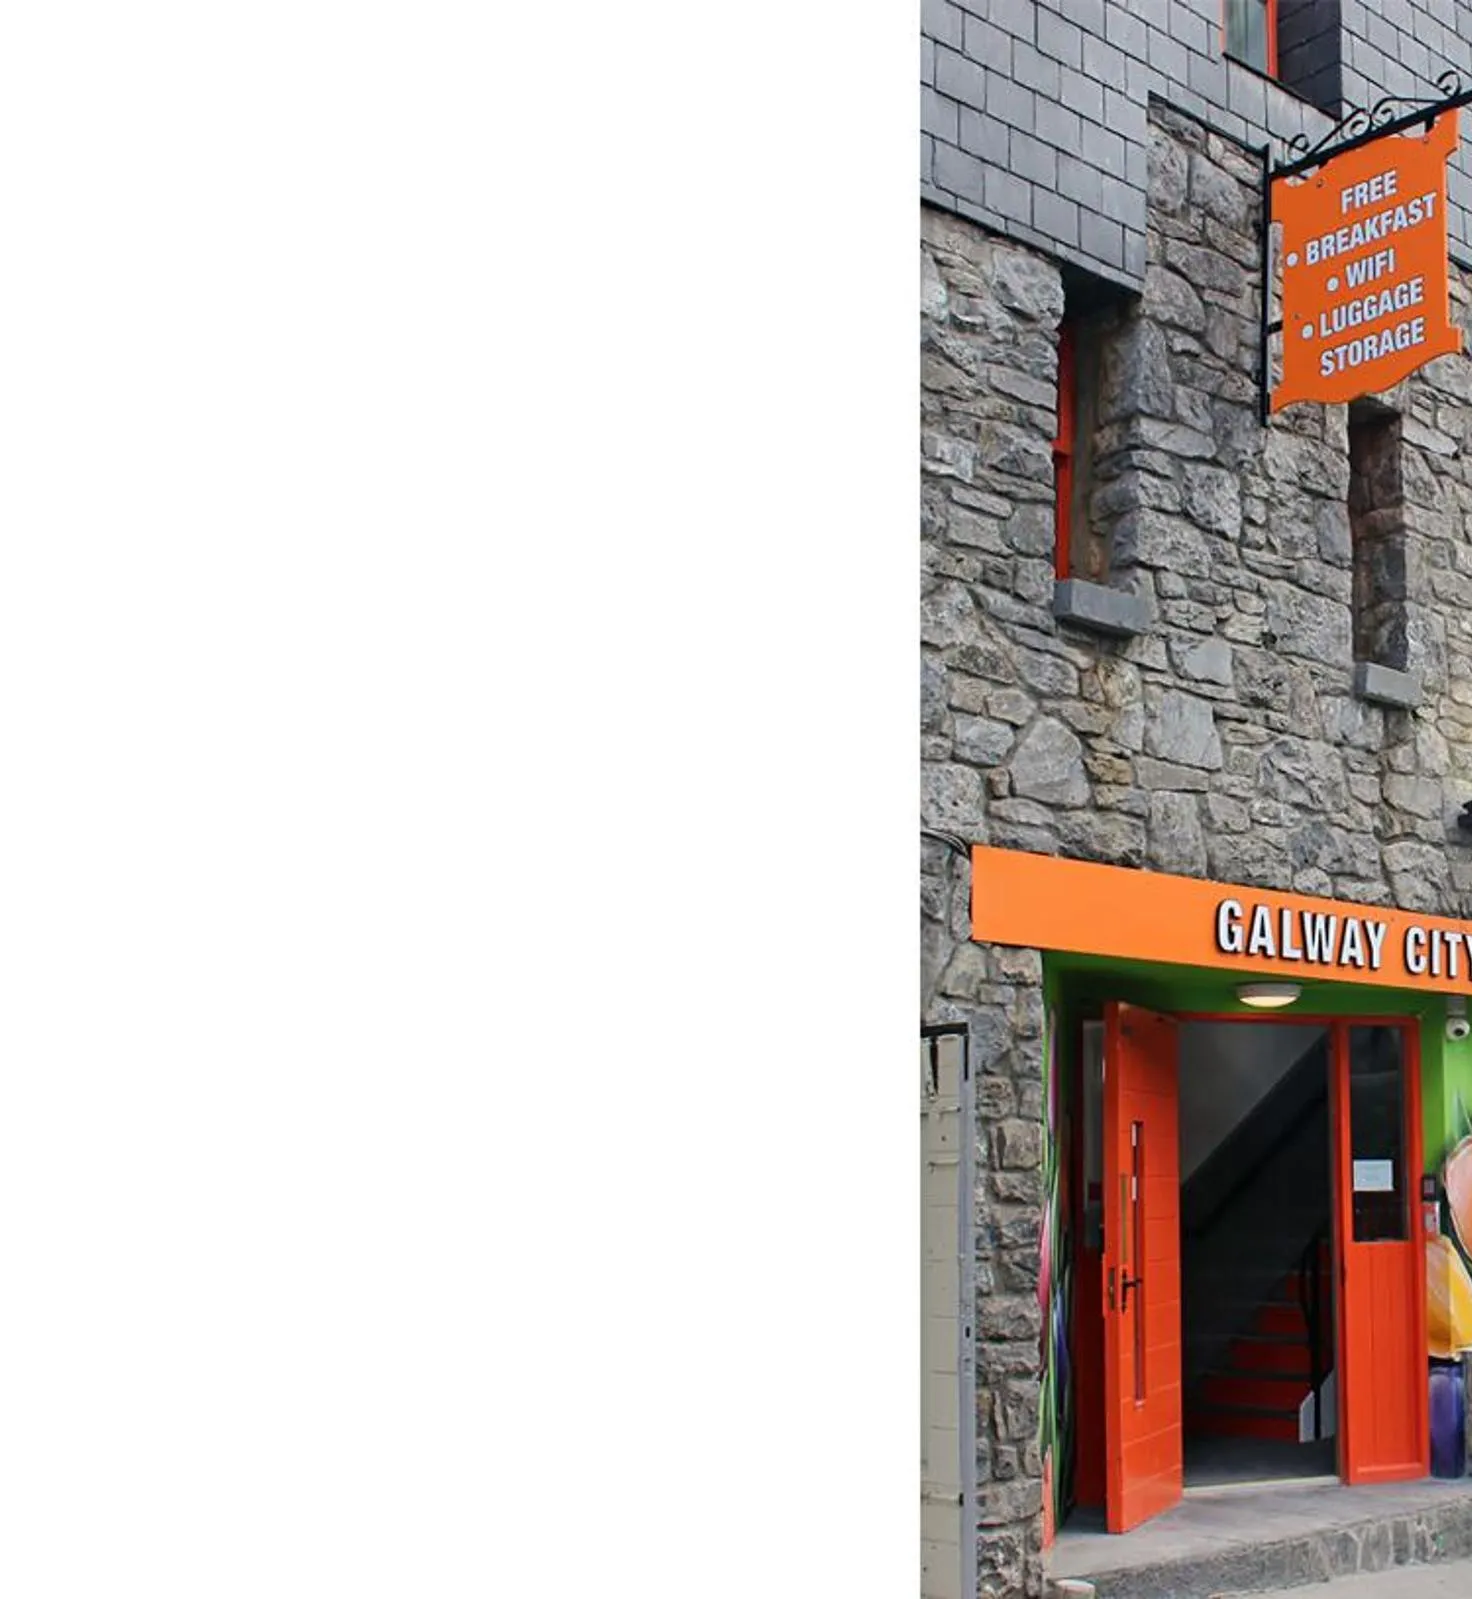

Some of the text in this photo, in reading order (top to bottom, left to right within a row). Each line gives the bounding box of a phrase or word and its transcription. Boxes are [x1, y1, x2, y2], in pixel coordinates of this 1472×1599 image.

[1340, 170, 1397, 214] FREE
[1305, 192, 1437, 265] BREAKFAST
[1345, 248, 1395, 288] WIFI
[1319, 276, 1425, 338] LUGGAGE
[1319, 317, 1425, 377] STORAGE
[1215, 899, 1387, 970] GALWAY
